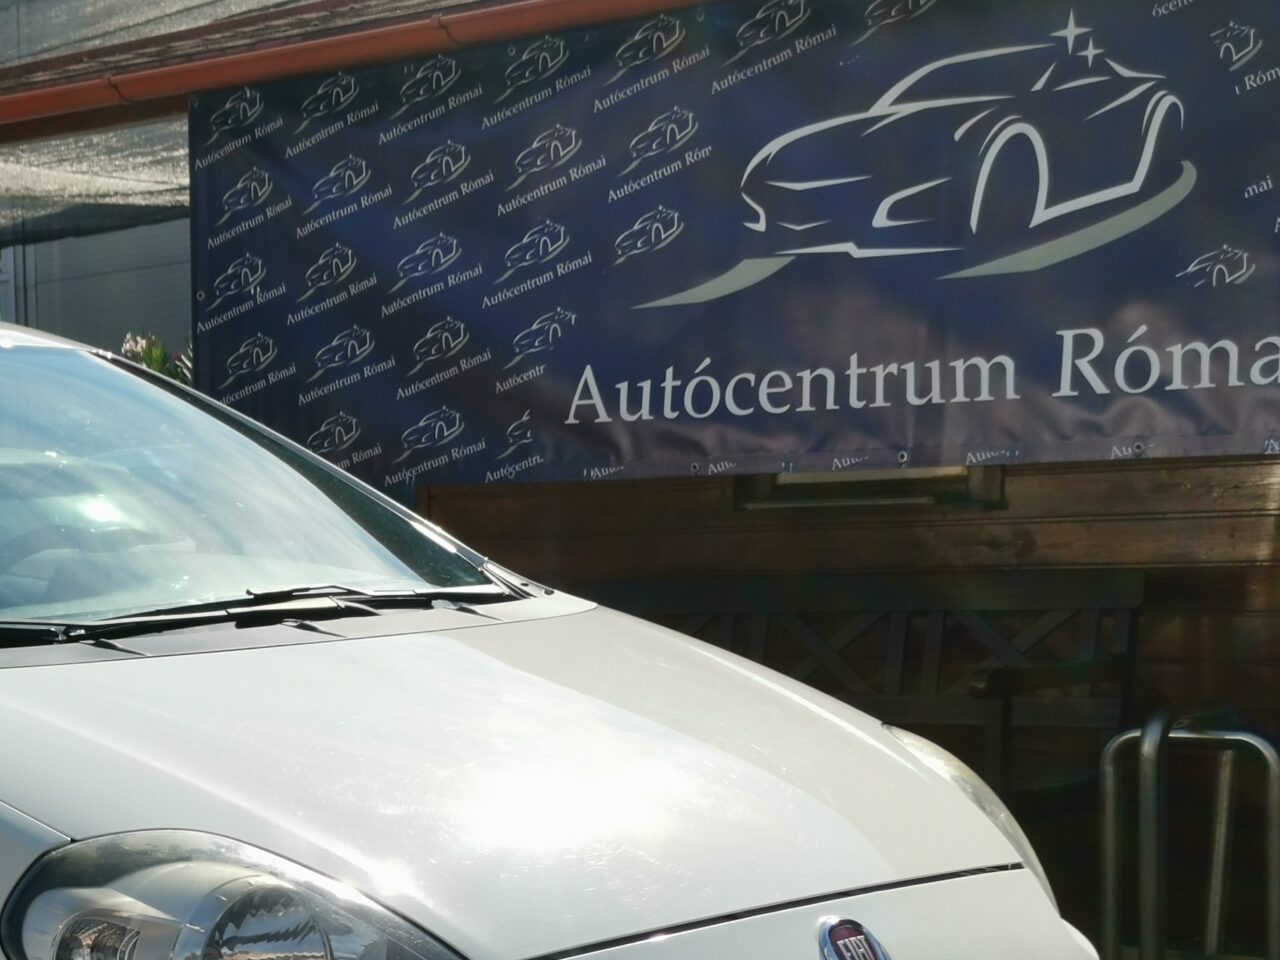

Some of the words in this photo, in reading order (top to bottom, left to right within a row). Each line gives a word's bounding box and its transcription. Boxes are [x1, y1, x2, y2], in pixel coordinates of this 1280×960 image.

[593, 68, 669, 113] Autócentrum
[671, 44, 711, 72] Római
[711, 48, 792, 94] Autócentrum
[795, 24, 838, 54] Római
[378, 106, 446, 145] Autócentrum
[448, 86, 484, 111] Római
[481, 89, 553, 130] Autócentrum
[555, 65, 592, 92] Római
[194, 135, 252, 171] Autócentrum
[254, 116, 284, 139] Római
[285, 121, 344, 159] Autócentrum
[346, 101, 379, 126] Római
[393, 190, 458, 230] Autócentrum
[460, 170, 494, 195] Római
[496, 176, 568, 217] Autócentrum
[570, 154, 607, 181] Római
[607, 159, 682, 203] Autócentrum
[207, 216, 265, 250] Autócentrum
[267, 195, 292, 219] Római
[296, 205, 358, 240] Autócentrum
[360, 184, 393, 209] Római
[196, 300, 254, 334] Autócentrum
[255, 282, 287, 306] Római
[286, 291, 348, 326] Autócentrum
[349, 273, 378, 298] Római
[381, 281, 445, 318] Autócentrum
[447, 263, 484, 287] Római
[481, 270, 554, 310] Autócentrum
[556, 251, 593, 278] Római
[268, 362, 297, 387] Római
[298, 372, 361, 406] Autócentrum
[363, 355, 396, 378] Római
[396, 364, 458, 400] Autócentrum
[460, 348, 492, 371] Római
[564, 352, 1021, 424] Autócentrum
[384, 455, 449, 487] Autócentrum
[451, 438, 486, 460] Római
